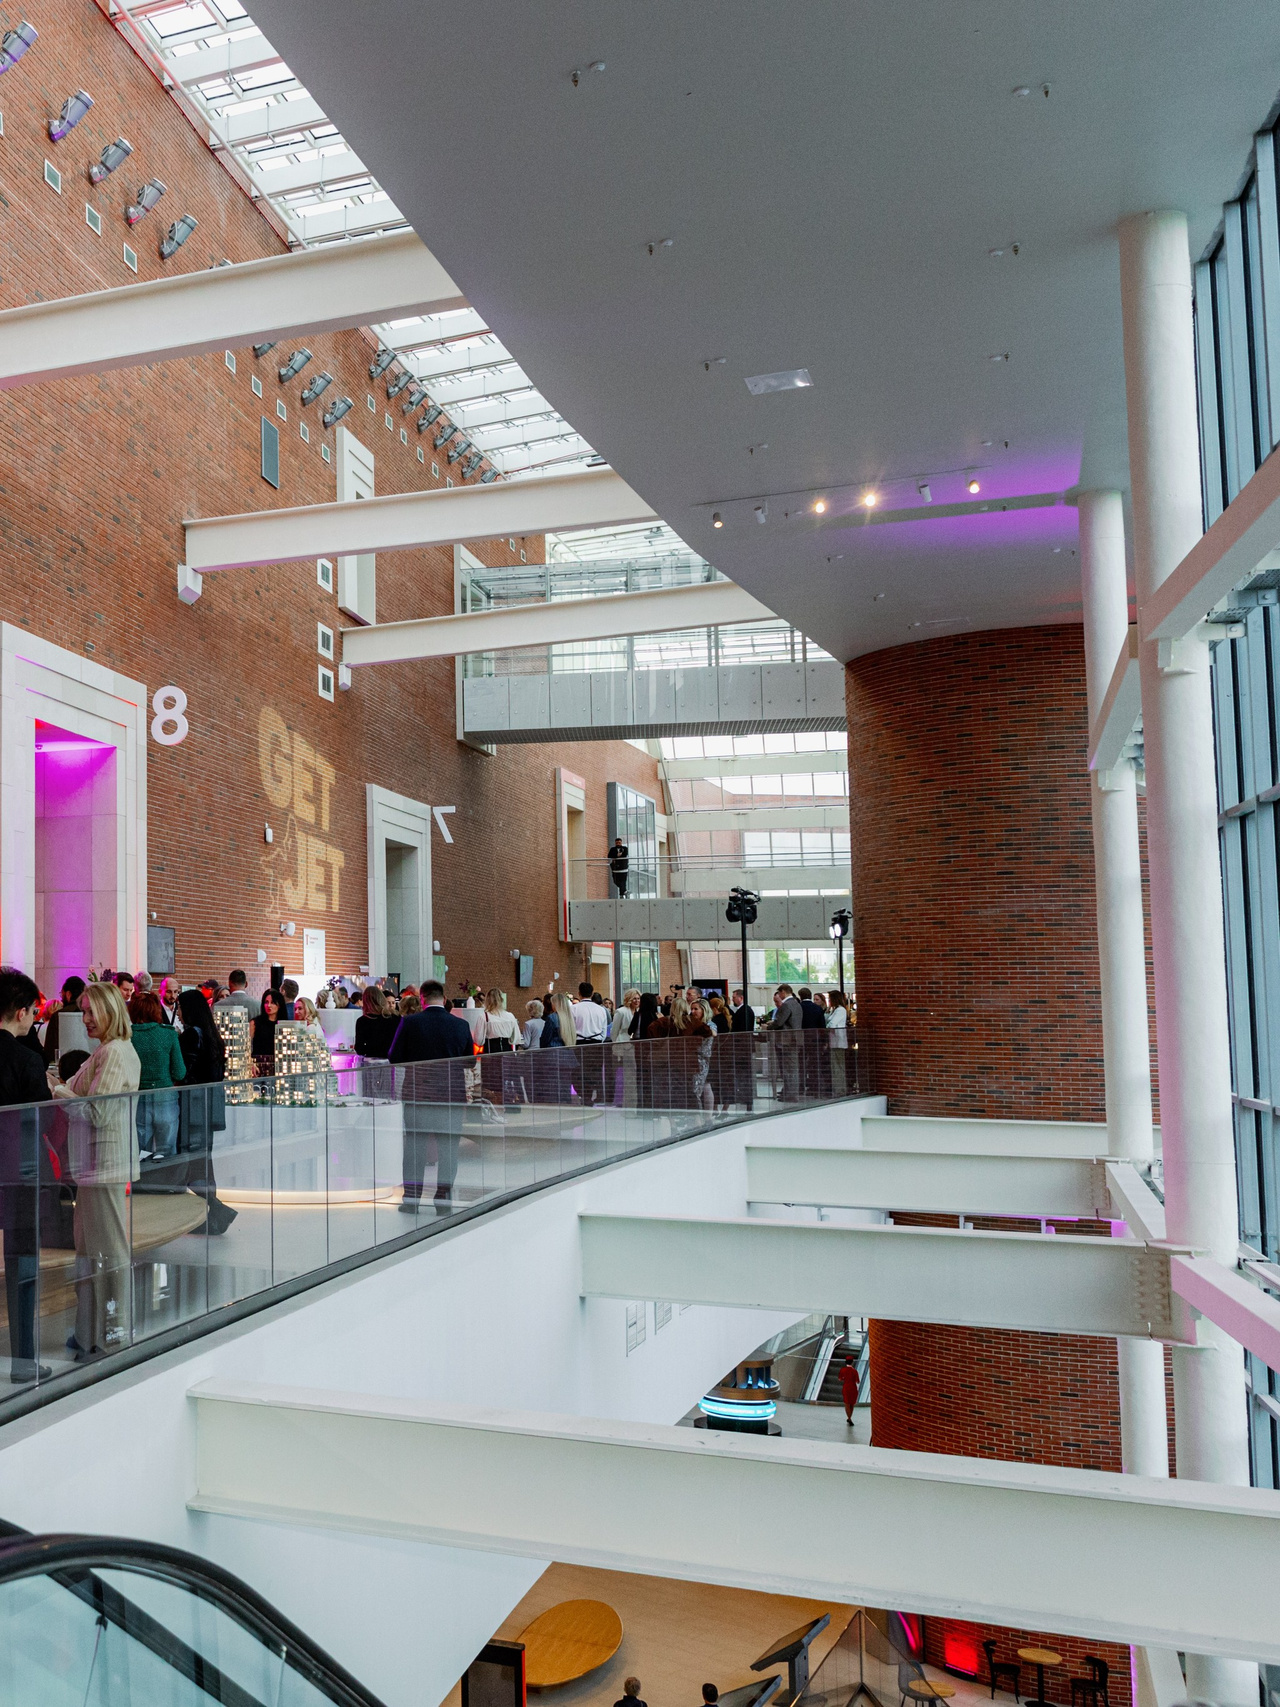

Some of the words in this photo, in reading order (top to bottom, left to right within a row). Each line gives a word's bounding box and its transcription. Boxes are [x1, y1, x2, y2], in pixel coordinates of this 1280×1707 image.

[151, 686, 188, 745] 8
[259, 705, 336, 832] GET
[283, 831, 345, 912] JET
